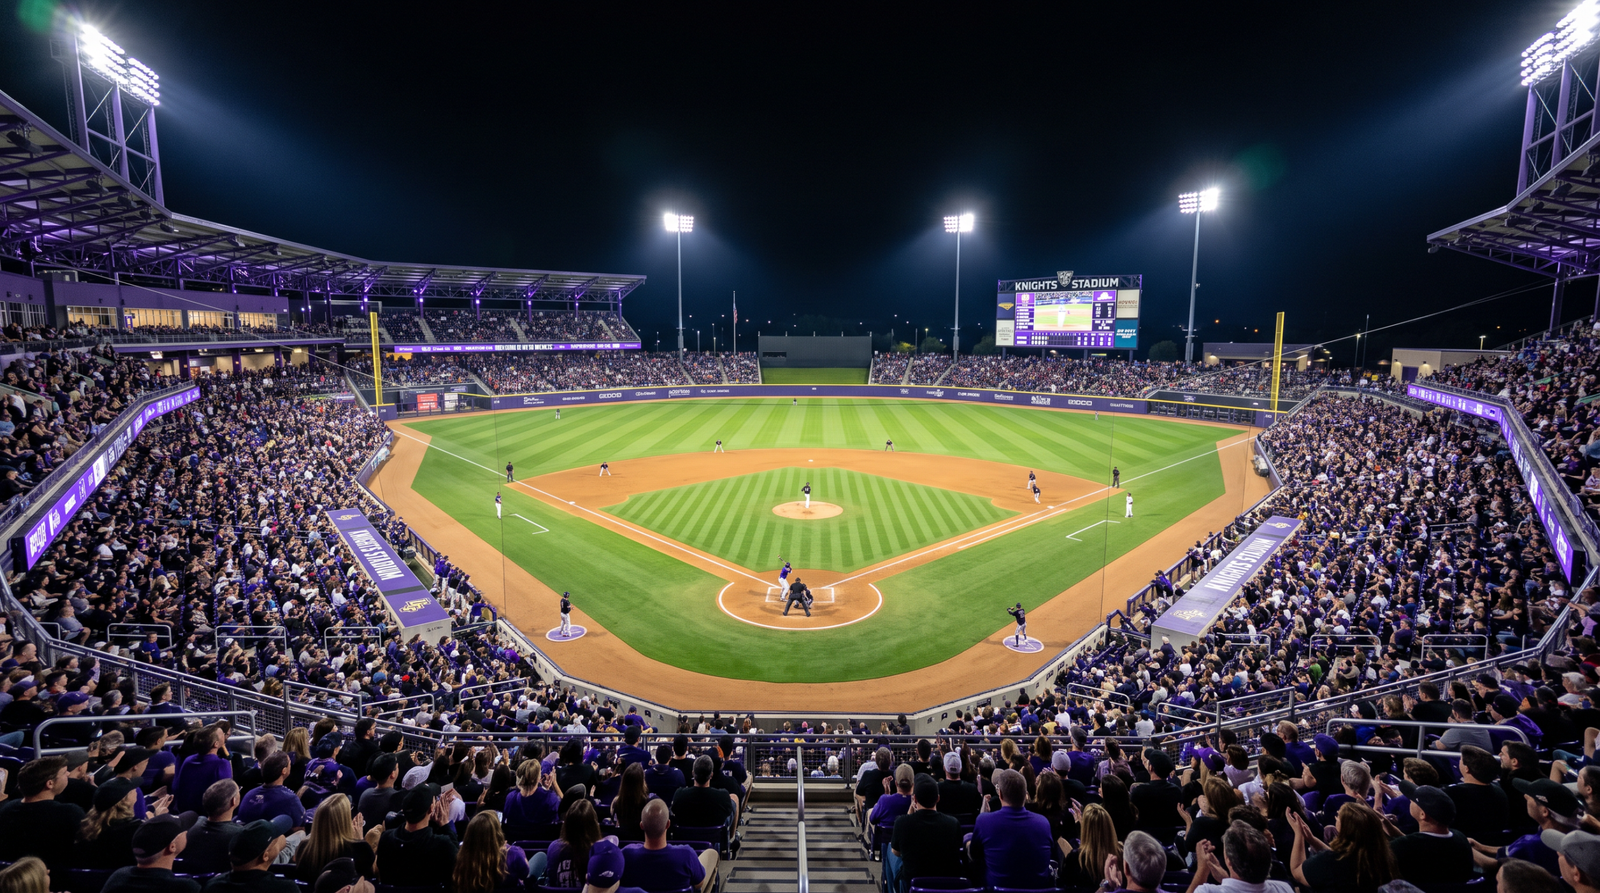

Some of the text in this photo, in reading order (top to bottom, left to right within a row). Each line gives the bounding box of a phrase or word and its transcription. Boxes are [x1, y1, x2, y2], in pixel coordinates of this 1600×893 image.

[1015, 278, 1119, 291] KNIGHTS STADIUM
[363, 550, 405, 581] STADIUM
[1203, 560, 1253, 593] KNIGHTS
